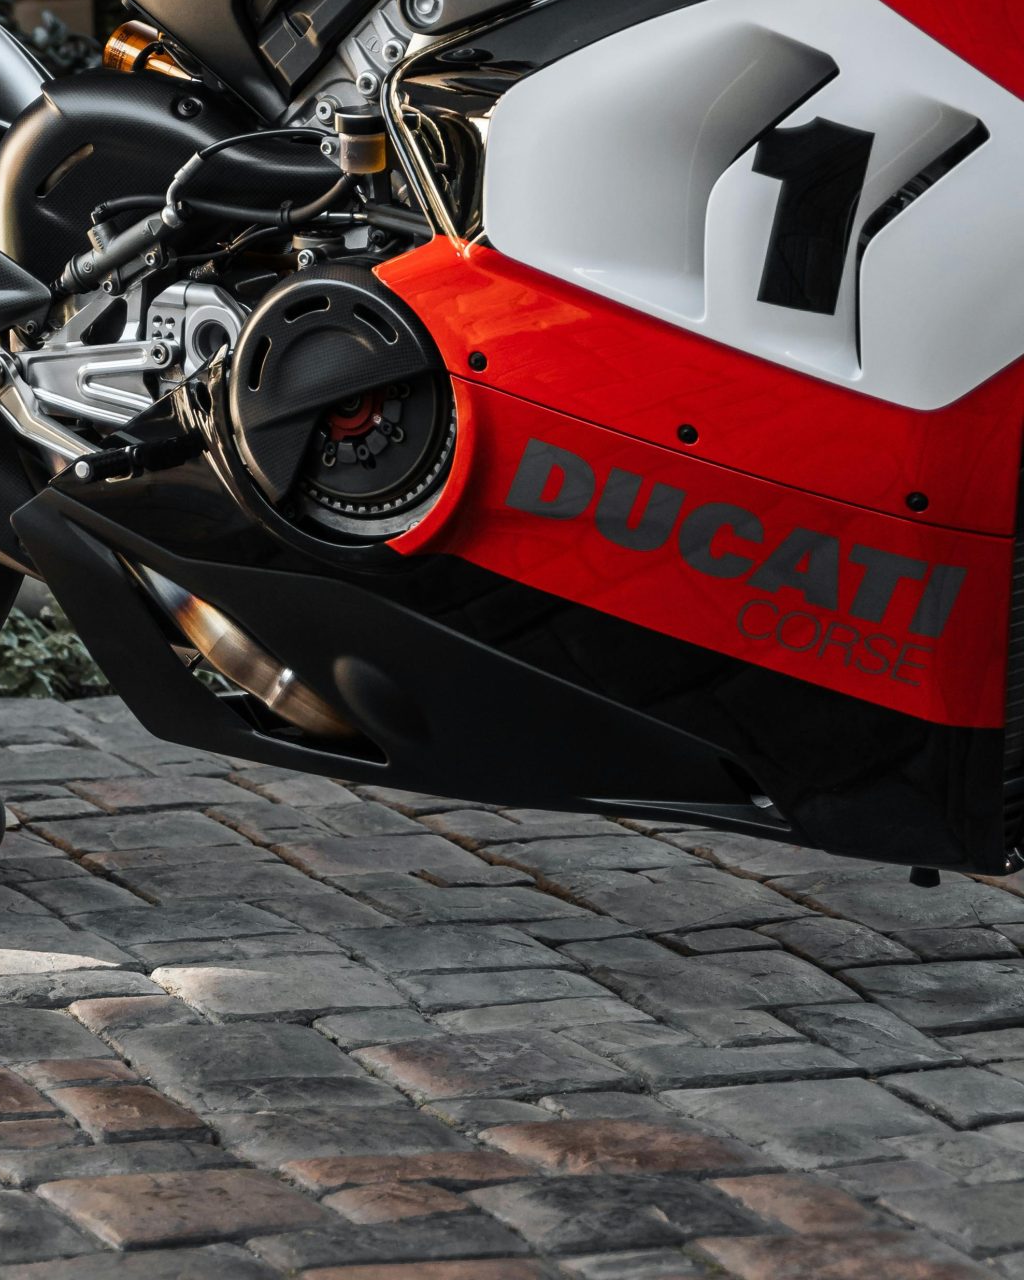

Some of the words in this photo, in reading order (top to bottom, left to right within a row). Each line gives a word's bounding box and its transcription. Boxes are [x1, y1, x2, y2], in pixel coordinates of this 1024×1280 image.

[752, 117, 875, 315] 1
[504, 438, 967, 638] DUCATI
[737, 599, 933, 686] CORSE
